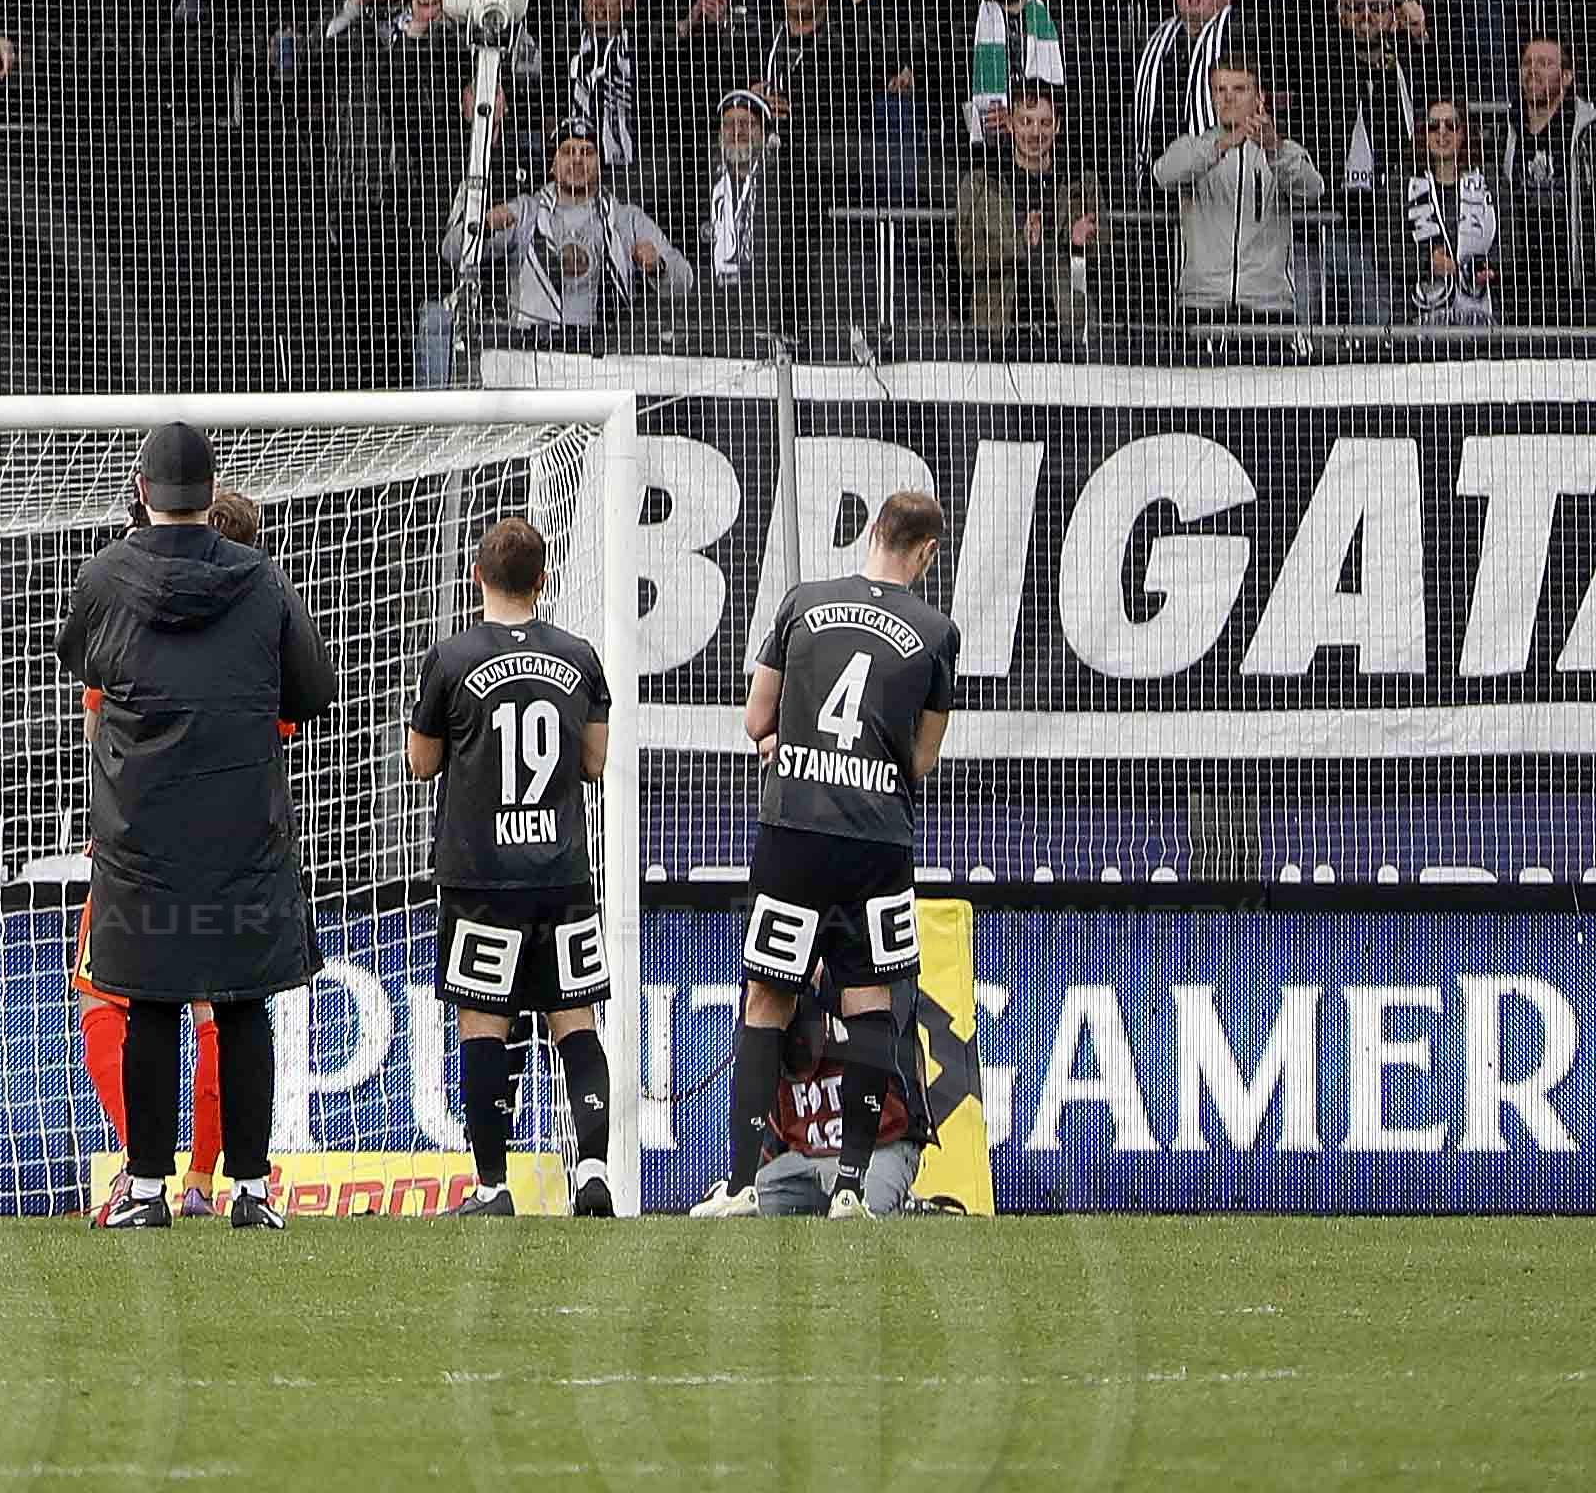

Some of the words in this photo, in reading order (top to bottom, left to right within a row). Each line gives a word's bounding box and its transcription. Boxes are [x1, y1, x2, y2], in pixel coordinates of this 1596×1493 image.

[634, 431, 1596, 681] BRIGAT
[811, 605, 918, 654] PUNTIGAMER
[472, 655, 576, 695] PUNTIGAMER
[816, 650, 874, 750] 4
[491, 699, 561, 807] 19
[777, 744, 899, 794] STANKOVIC
[495, 808, 557, 845] KUEN
